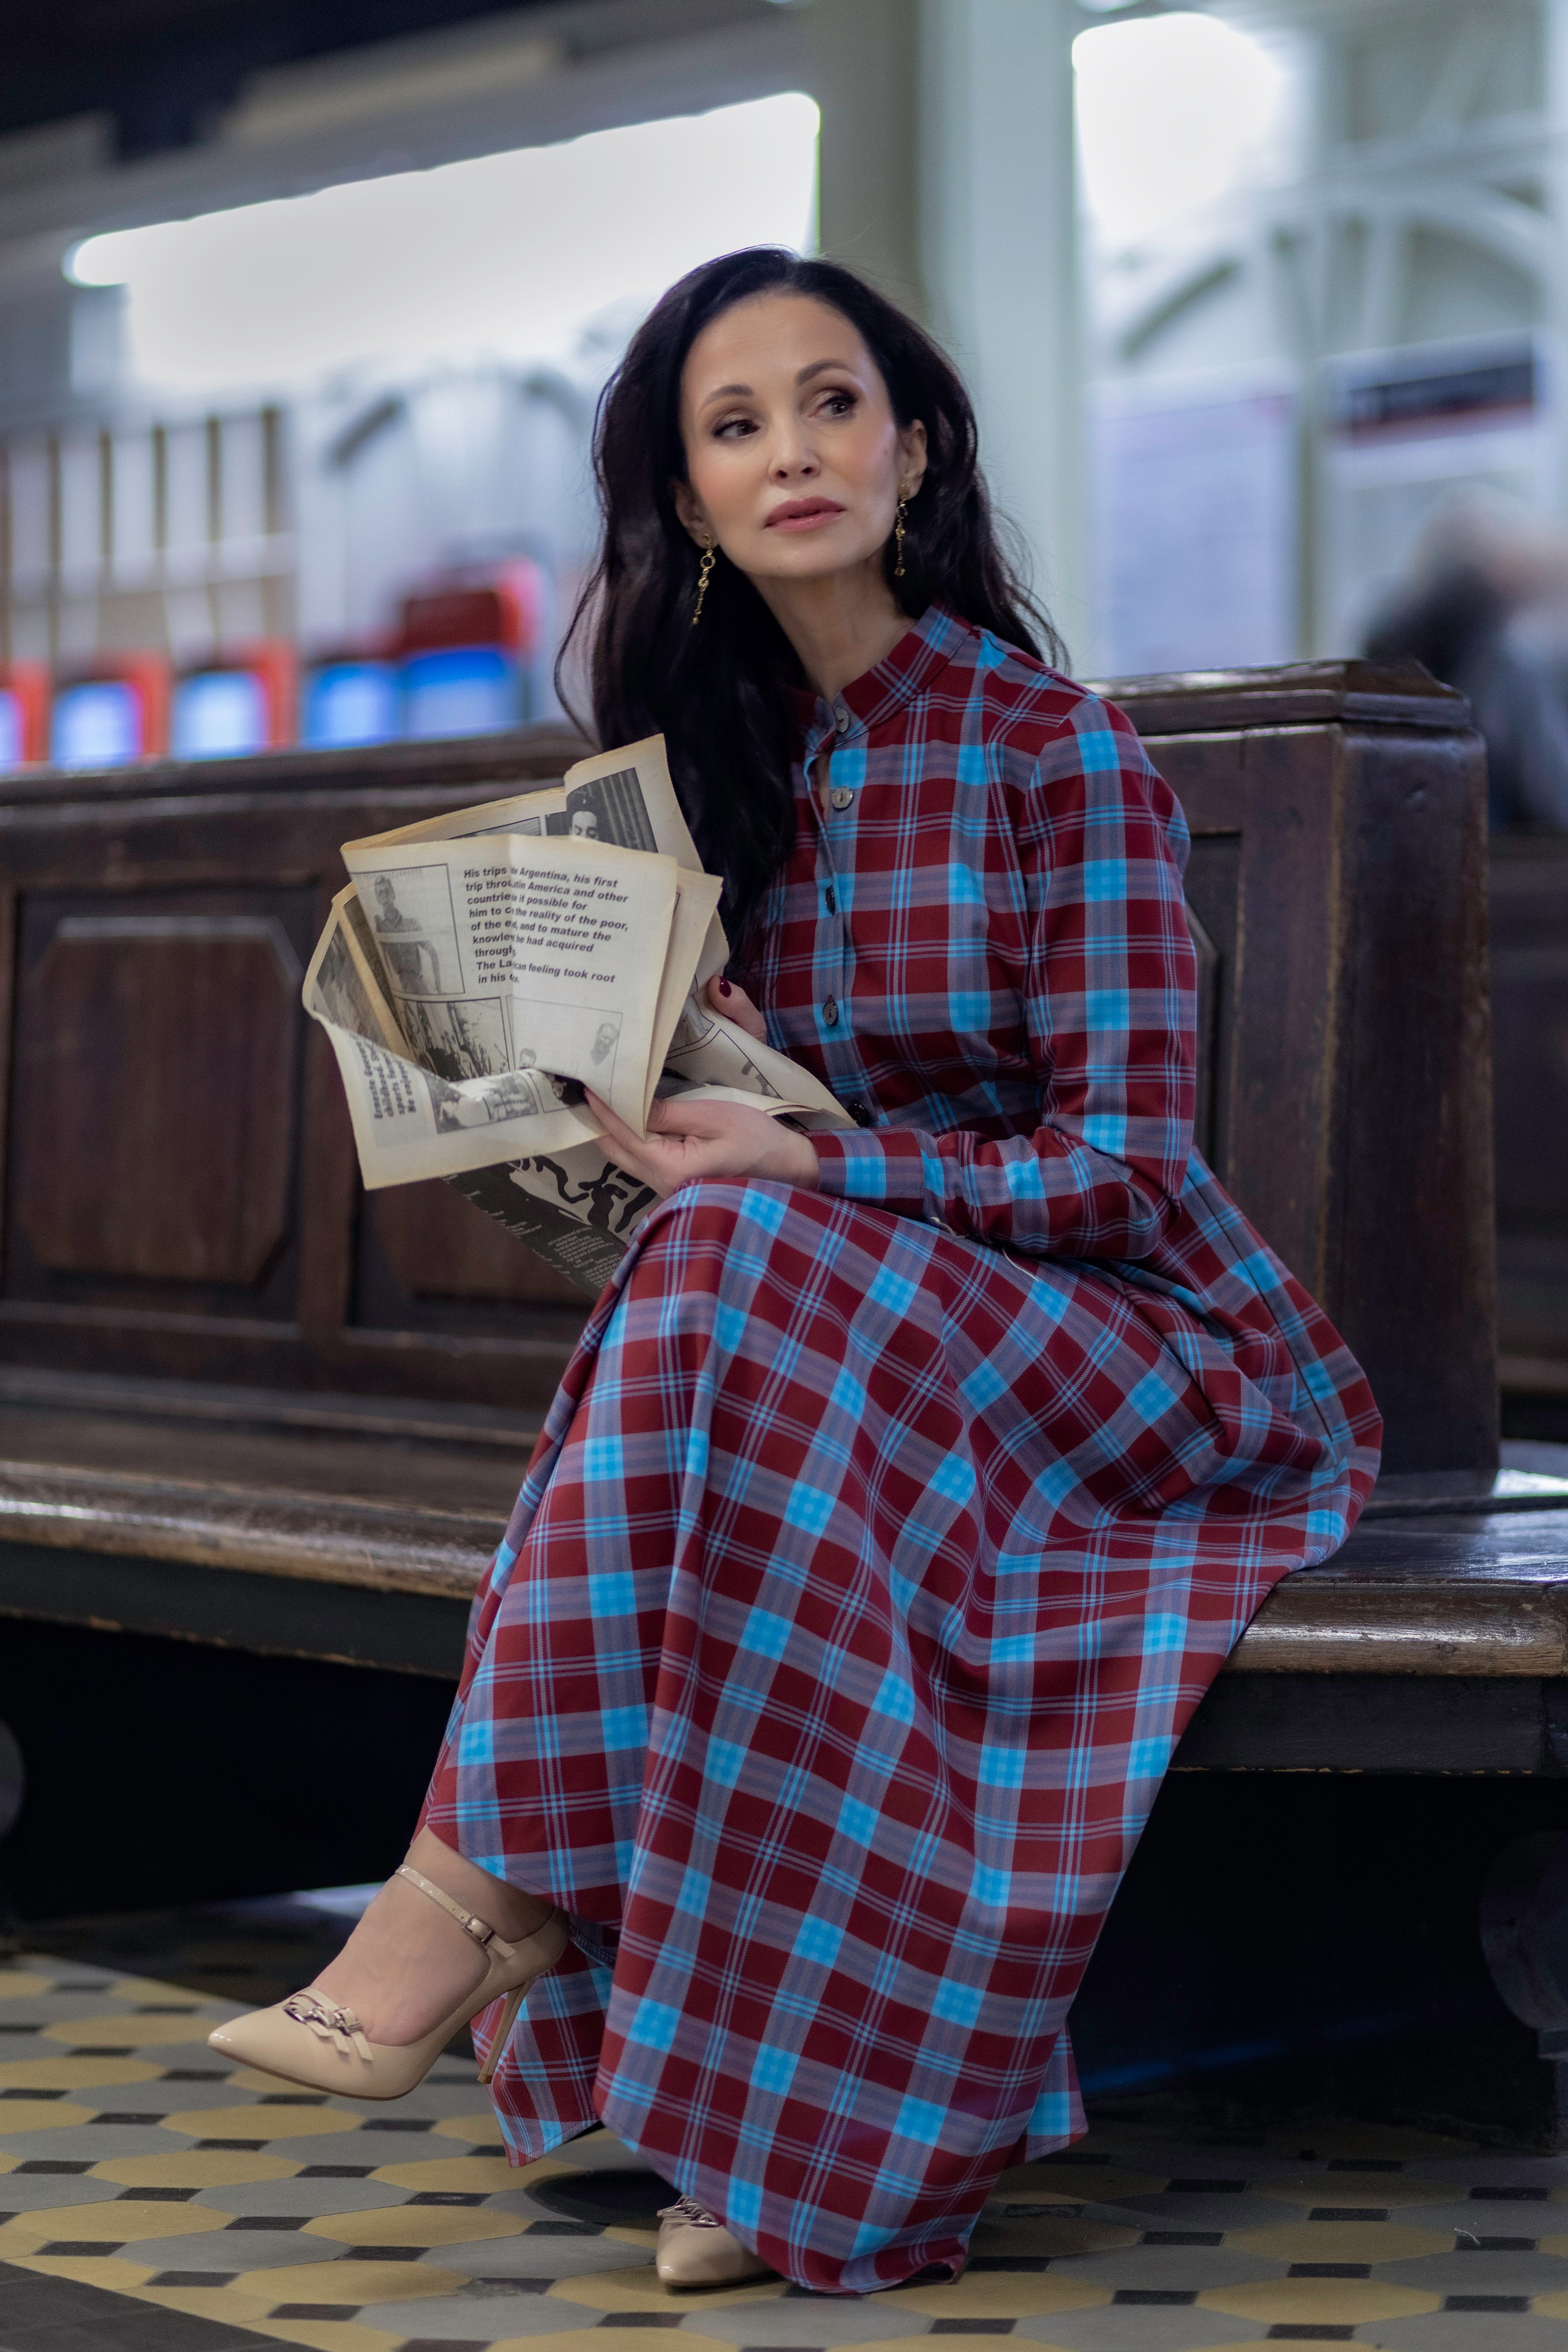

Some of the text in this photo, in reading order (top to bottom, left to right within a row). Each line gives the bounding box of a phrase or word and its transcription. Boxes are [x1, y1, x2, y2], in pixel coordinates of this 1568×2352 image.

[464, 869, 480, 878] His
[483, 867, 507, 878] trips
[519, 867, 570, 883] Argentina,
[573, 873, 590, 884] his
[594, 876, 619, 888] first
[466, 882, 483, 892] trip
[528, 881, 570, 895] America
[573, 889, 595, 899] and
[597, 892, 629, 903] other
[519, 894, 526, 903] it
[526, 895, 569, 908] possible
[571, 900, 588, 911] for
[469, 908, 488, 918] him
[491, 907, 502, 916] to
[516, 907, 527, 916] the
[529, 910, 562, 922] reality
[564, 914, 576, 922] of
[579, 915, 597, 925] the
[600, 919, 629, 932] poor,
[471, 921, 481, 931] of
[484, 920, 502, 930] the
[519, 922, 535, 931] and
[538, 924, 548, 933] to
[550, 926, 589, 938] mature
[592, 931, 612, 941] the
[516, 934, 525, 943] he
[527, 935, 544, 946] had
[546, 939, 594, 952] acquired
[477, 961, 496, 971] The
[529, 962, 560, 977] feeling
[564, 968, 589, 979] took
[591, 973, 616, 983] root
[478, 974, 488, 984] in
[491, 973, 506, 983] his
